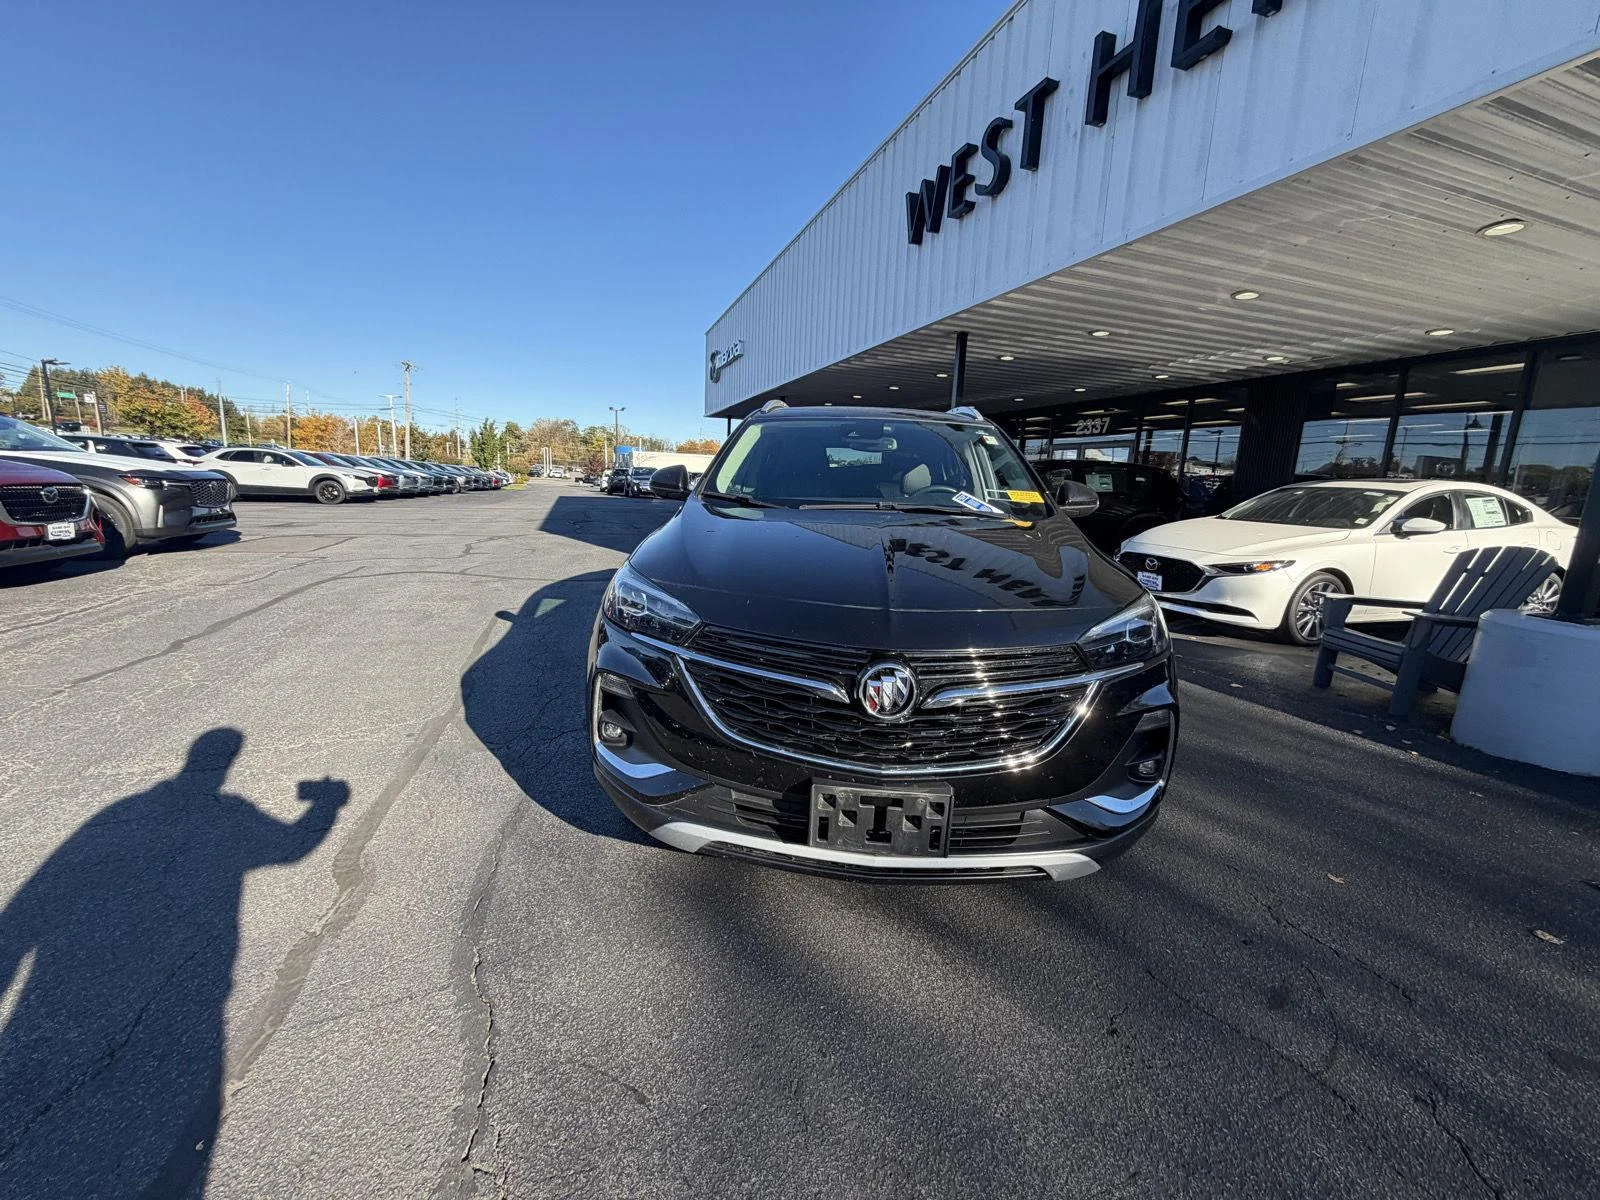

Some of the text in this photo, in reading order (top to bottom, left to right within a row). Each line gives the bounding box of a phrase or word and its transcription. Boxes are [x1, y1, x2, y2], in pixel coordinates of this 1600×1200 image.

[906, 0, 1283, 245] WEST HE
[1076, 416, 1110, 435] 2337
